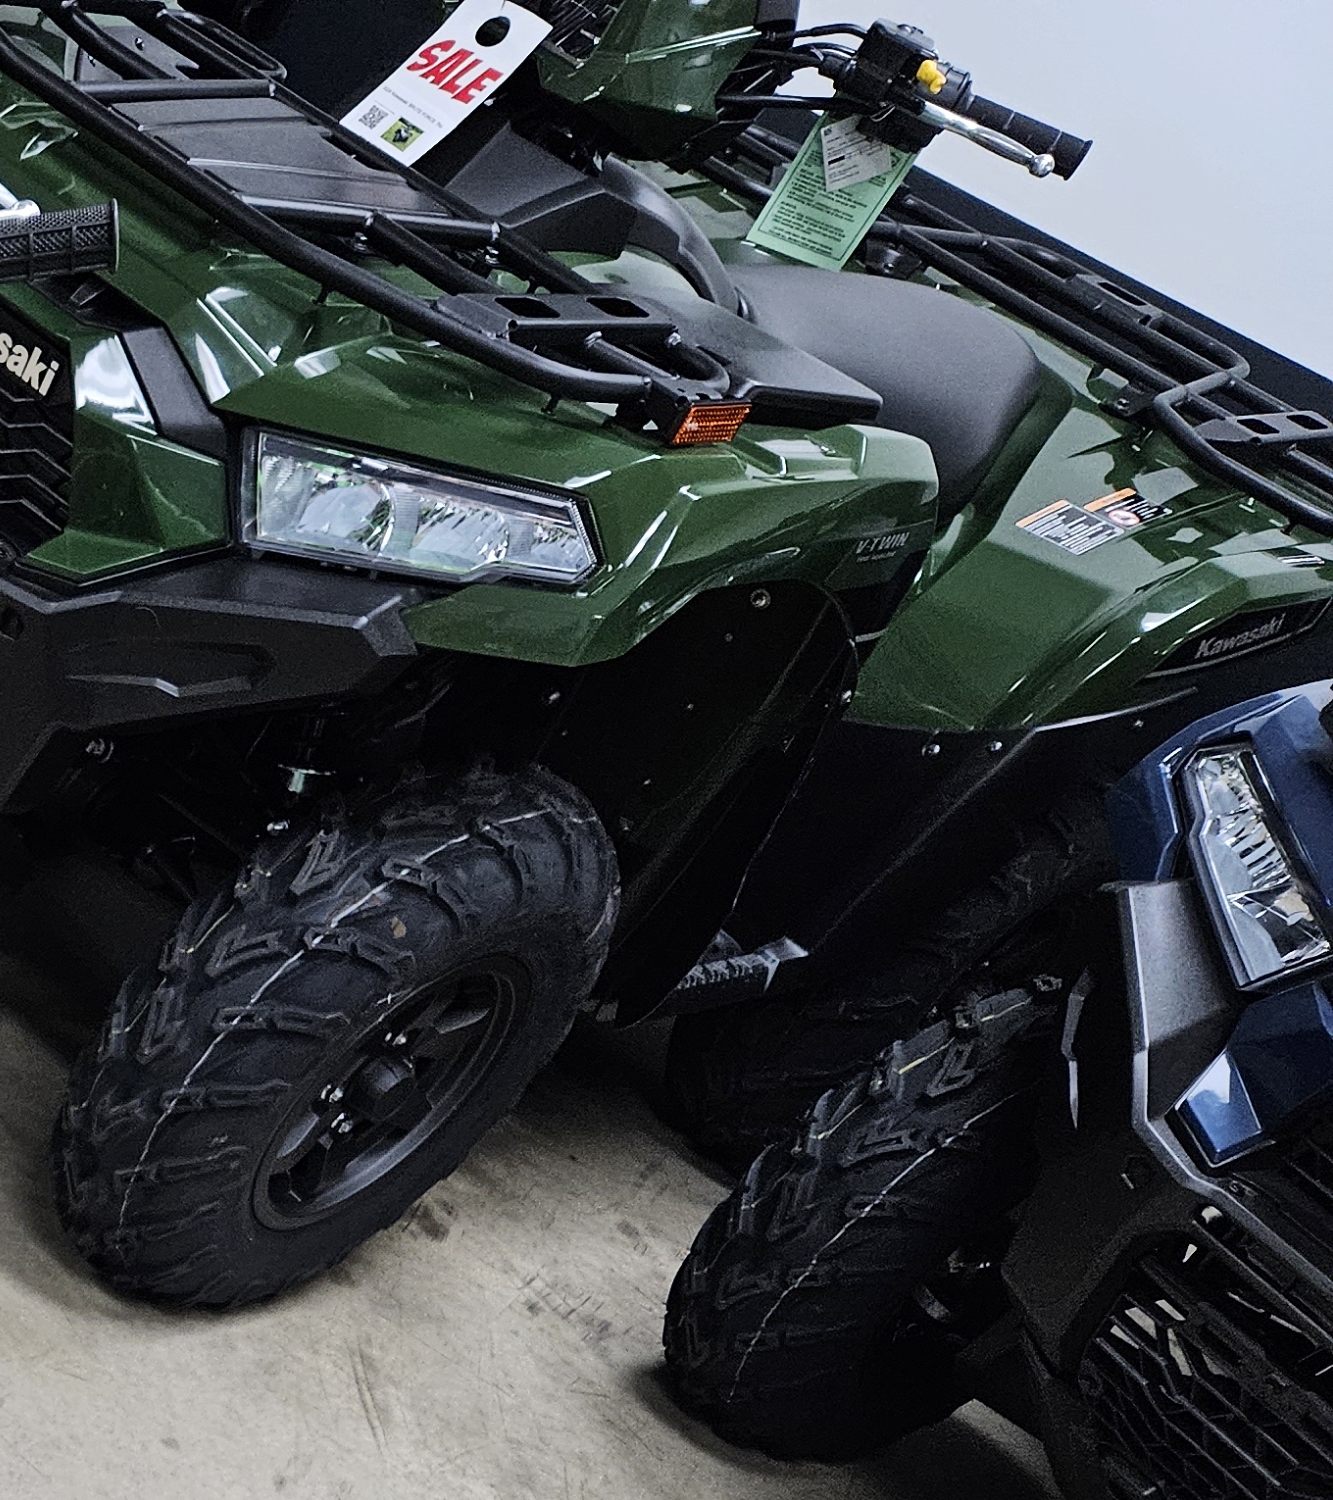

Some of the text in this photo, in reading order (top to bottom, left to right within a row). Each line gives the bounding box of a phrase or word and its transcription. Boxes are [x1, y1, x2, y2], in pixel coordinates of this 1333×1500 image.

[406, 39, 504, 104] SALE
[856, 531, 910, 554] V-TWIN
[1193, 611, 1287, 660] Kawasaki
